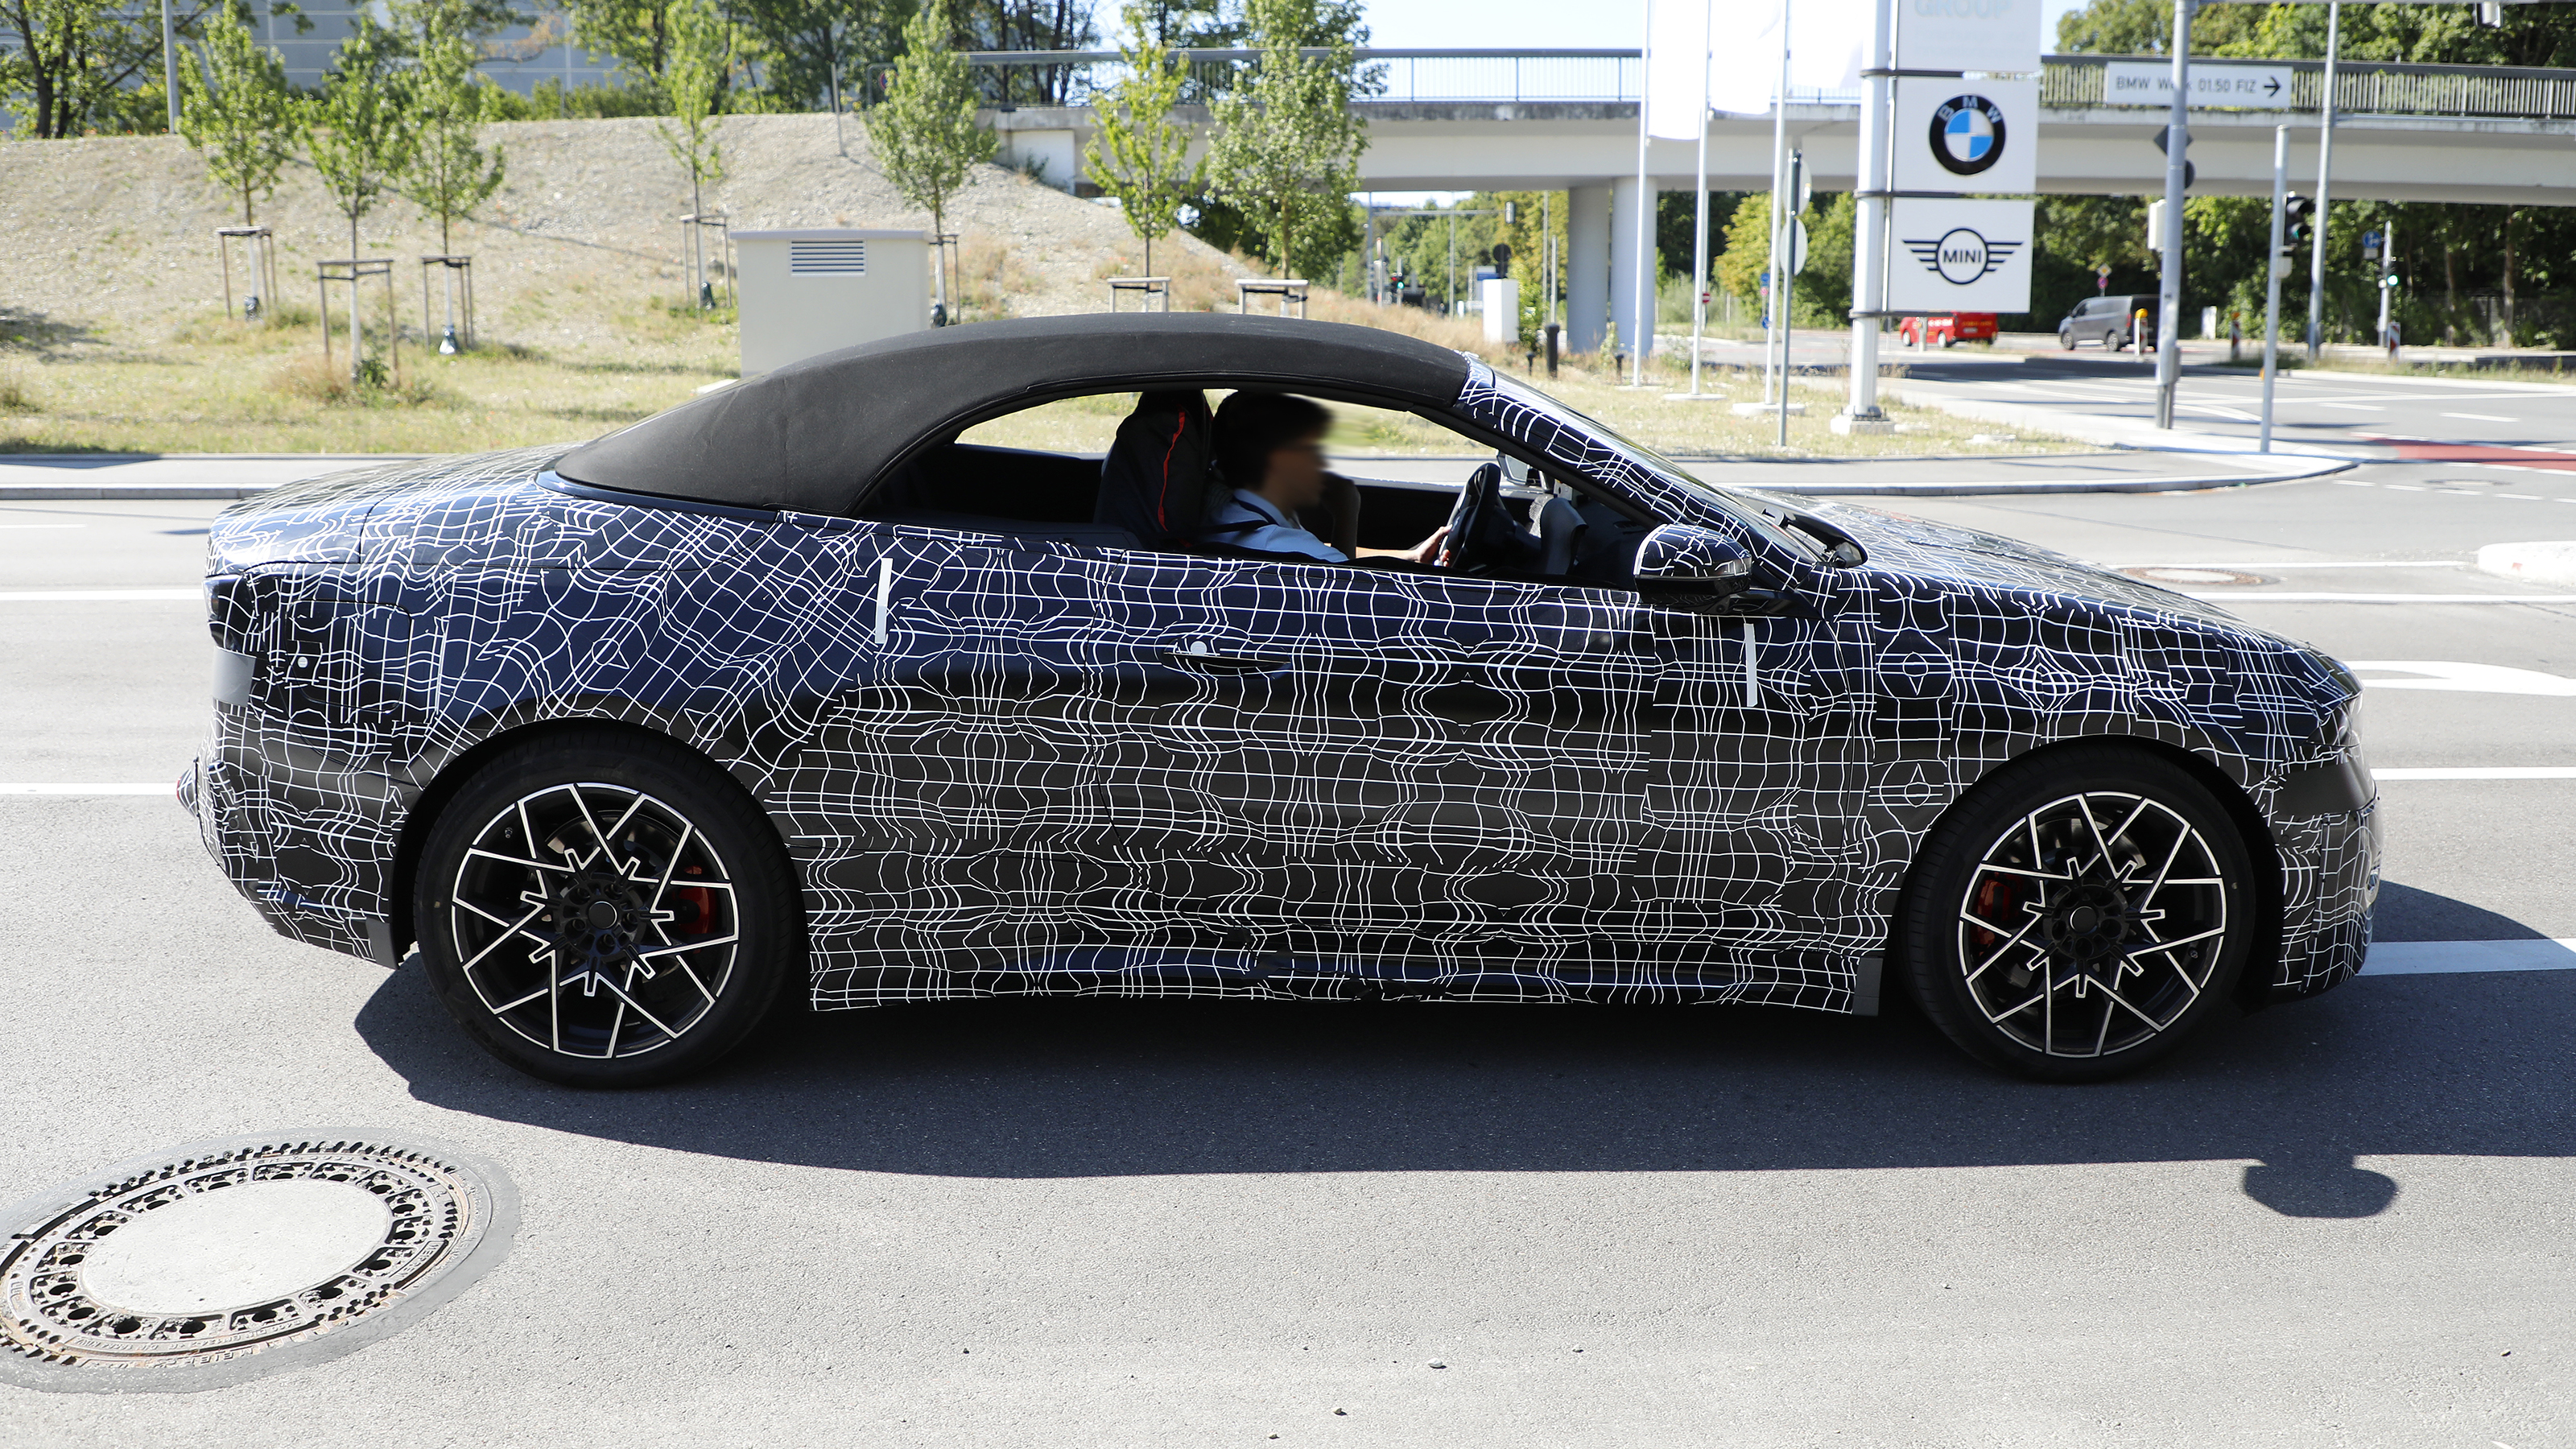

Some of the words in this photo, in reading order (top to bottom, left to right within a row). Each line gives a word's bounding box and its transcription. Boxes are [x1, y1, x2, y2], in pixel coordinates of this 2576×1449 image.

[1914, 0, 2013, 19] GROUP
[2116, 75, 2150, 90] BMW
[2198, 77, 2231, 93] 01.50
[2235, 79, 2256, 93] FIZ
[1937, 95, 2002, 123] BMW
[1943, 250, 1982, 263] MINI
